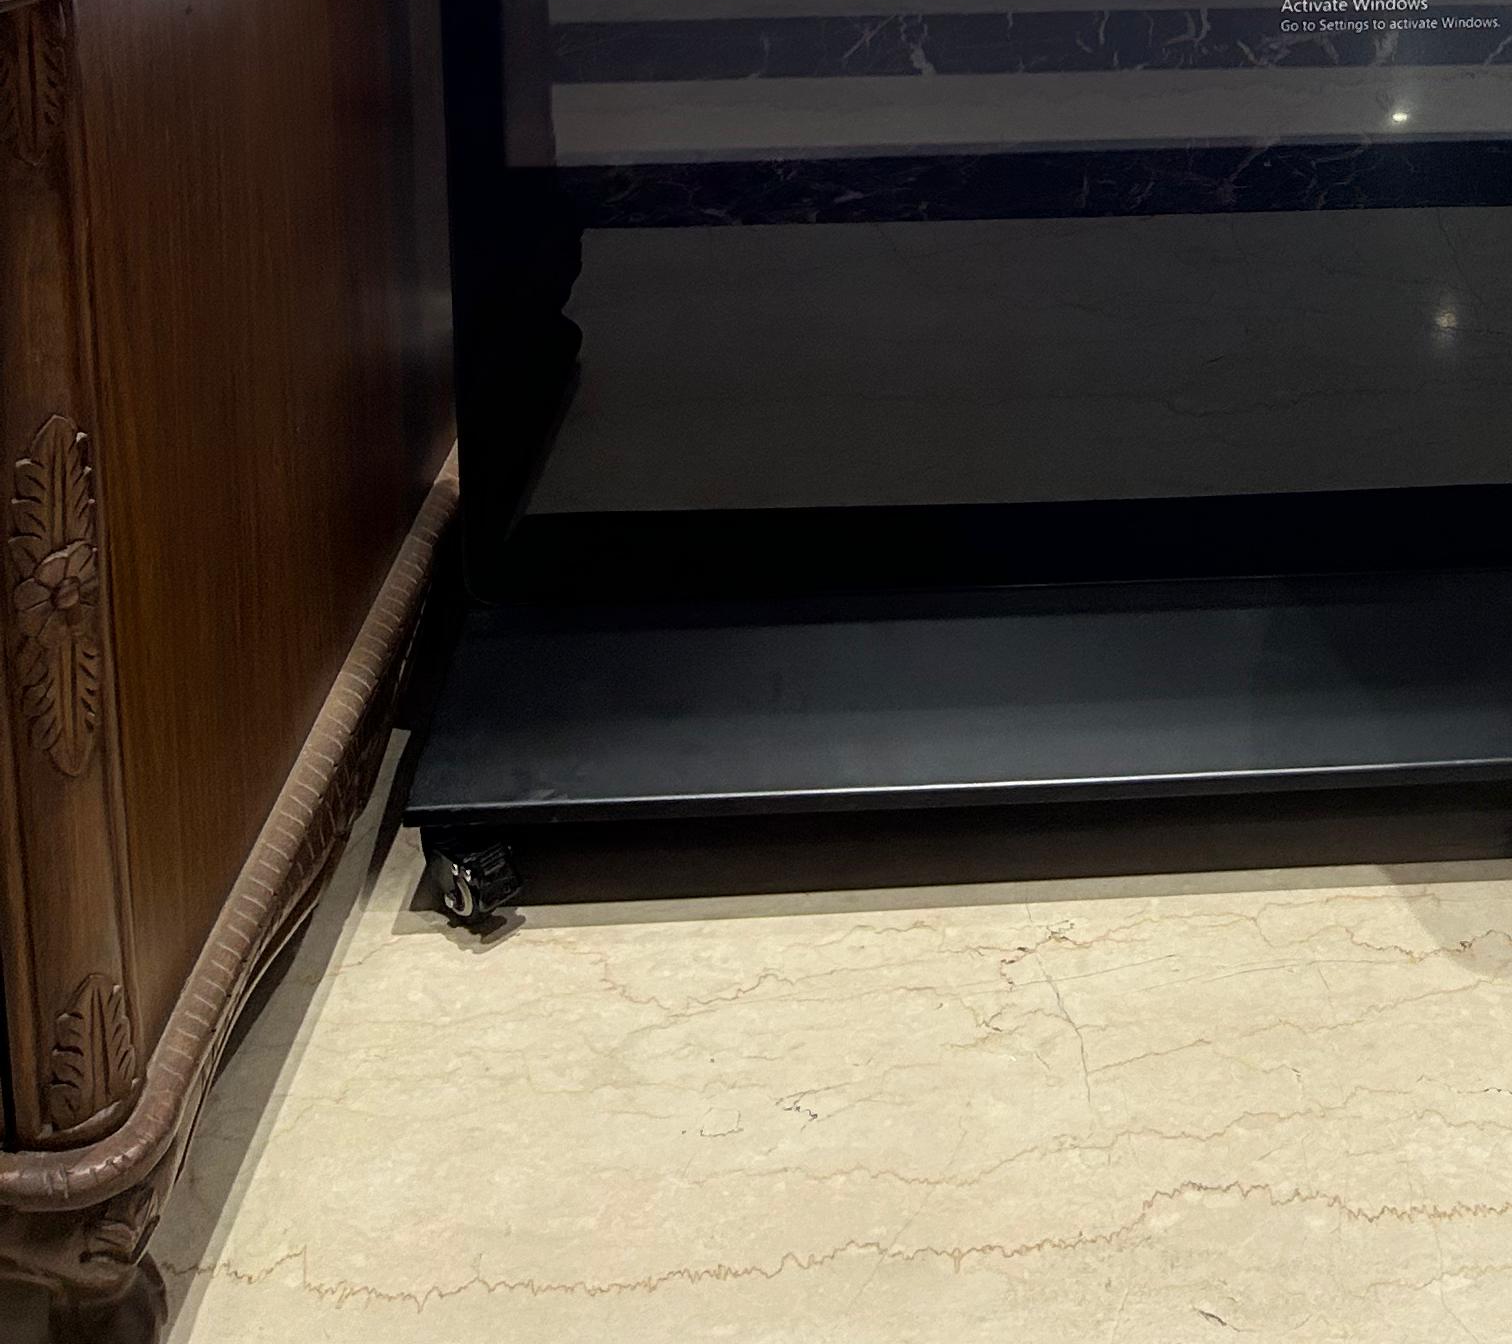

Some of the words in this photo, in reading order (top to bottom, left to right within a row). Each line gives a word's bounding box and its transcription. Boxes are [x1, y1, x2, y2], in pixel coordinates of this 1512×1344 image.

[1281, 19, 1299, 32] Go
[1303, 21, 1316, 31] to
[1319, 18, 1369, 33] Settings
[1373, 19, 1385, 30] to
[1389, 18, 1438, 30] activate
